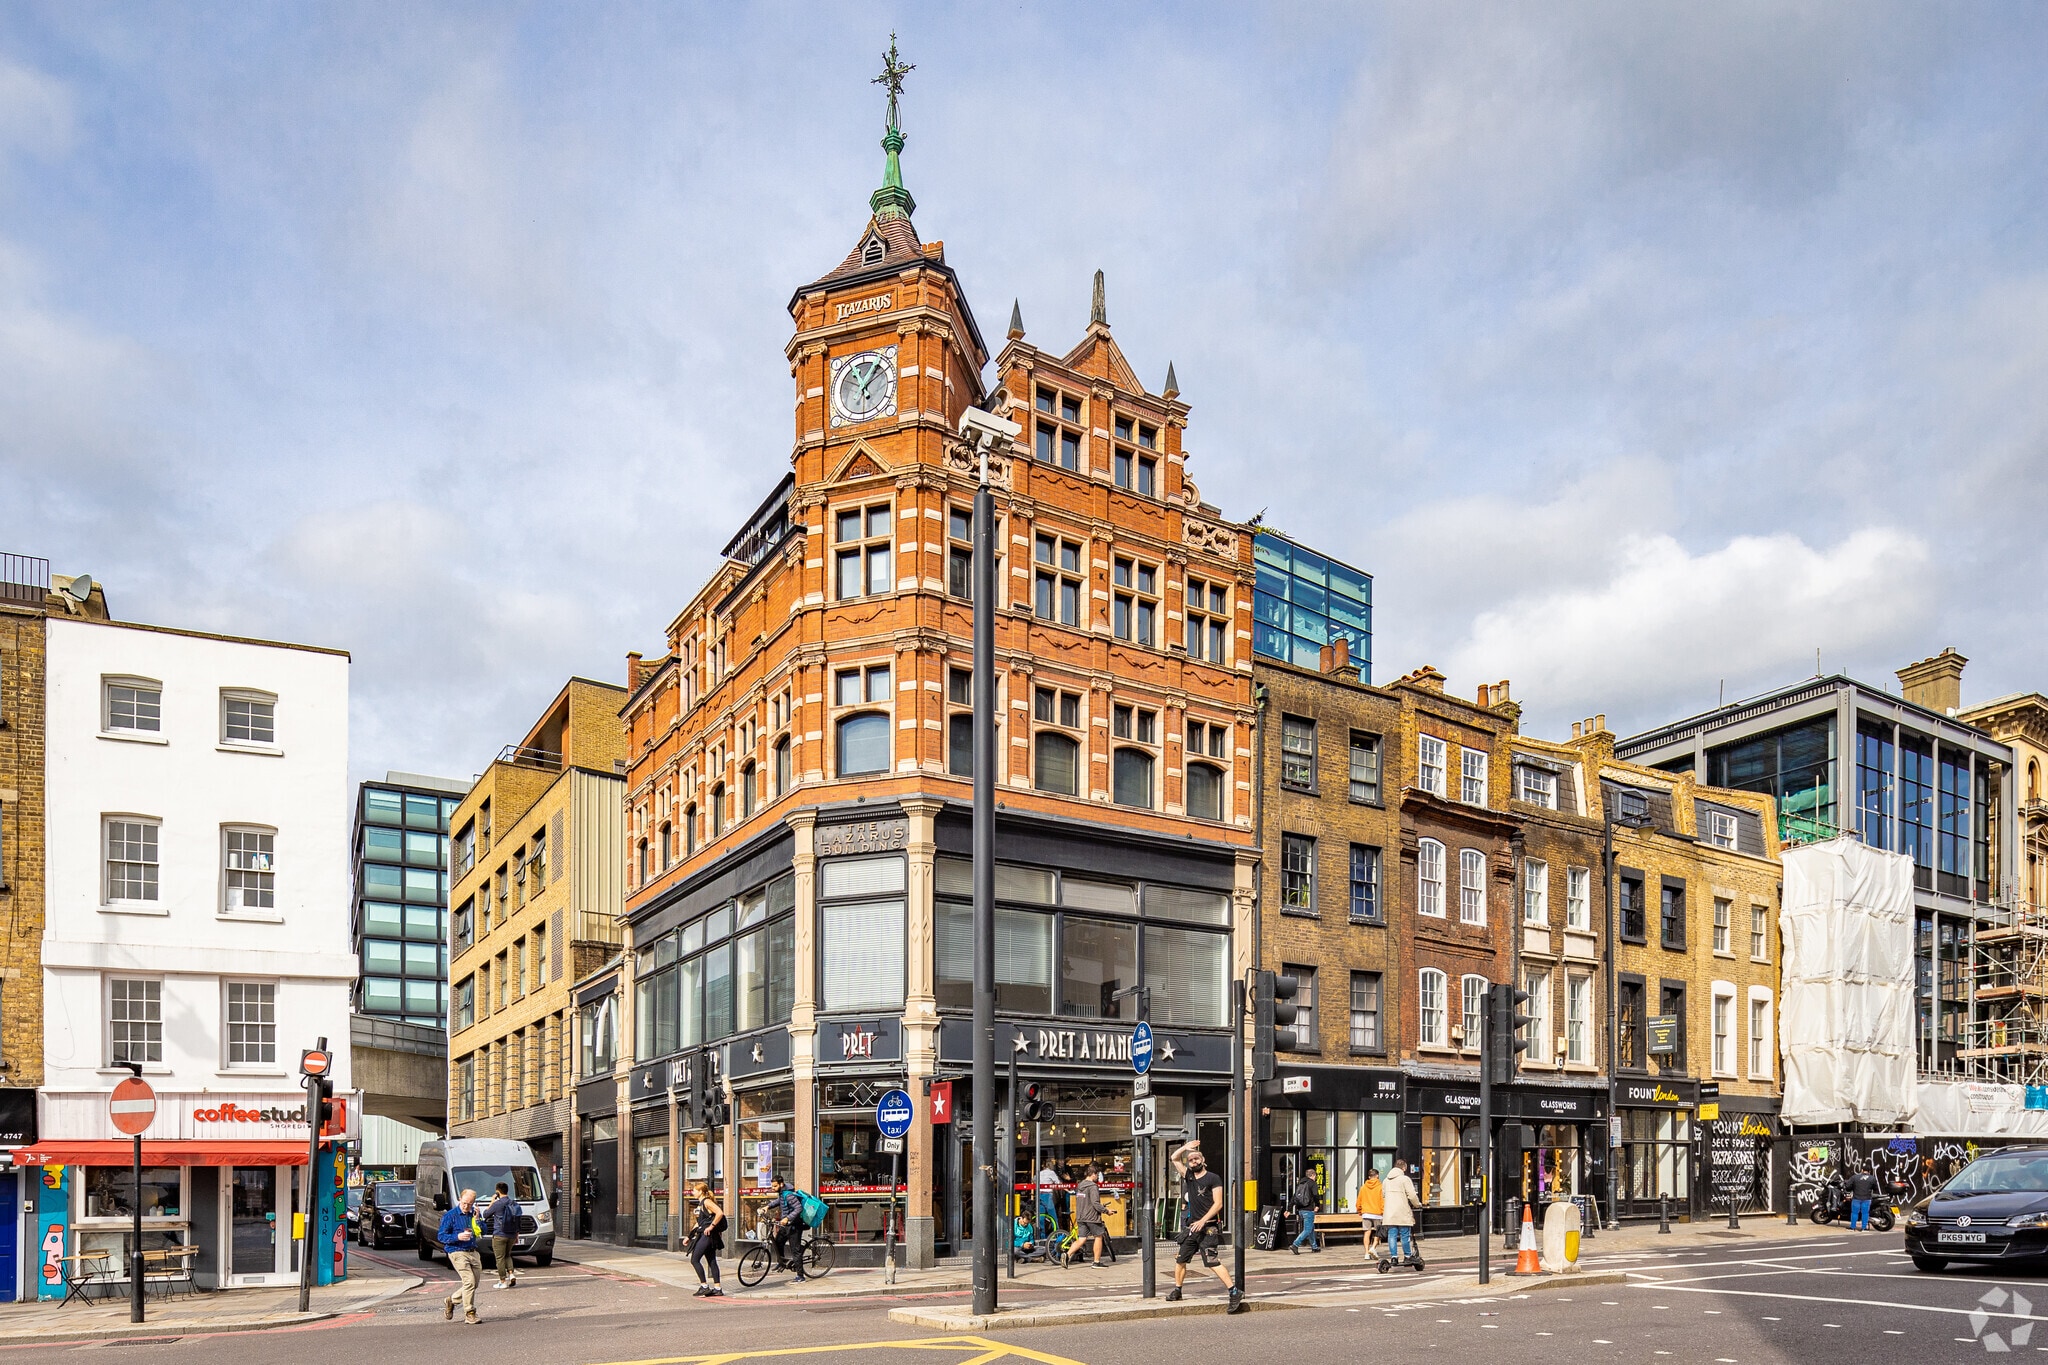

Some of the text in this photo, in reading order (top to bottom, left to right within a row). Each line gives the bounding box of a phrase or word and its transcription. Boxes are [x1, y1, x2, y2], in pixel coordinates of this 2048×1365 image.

[847, 822, 877, 833] THE
[820, 827, 904, 845] LAZARUS
[822, 839, 901, 855] BUILDING
[843, 1032, 874, 1055] PRET
[1039, 1030, 1075, 1058] PRET
[1080, 1033, 1090, 1059] A
[1135, 1082, 1147, 1091] Only
[1378, 1081, 1396, 1091] EDWIN
[1628, 1087, 1657, 1099] FOUNT
[1445, 1095, 1481, 1106] GLASSWOR
[1540, 1100, 1577, 1110] GLASSWORKS
[193, 1103, 307, 1122] coffeestud
[887, 1126, 902, 1134] taxi
[1712, 1121, 1743, 1135] FOUNT
[886, 1141, 900, 1149] Only
[1712, 1137, 1755, 1147] SELF SPACE
[1941, 1233, 1963, 1241] PK69
